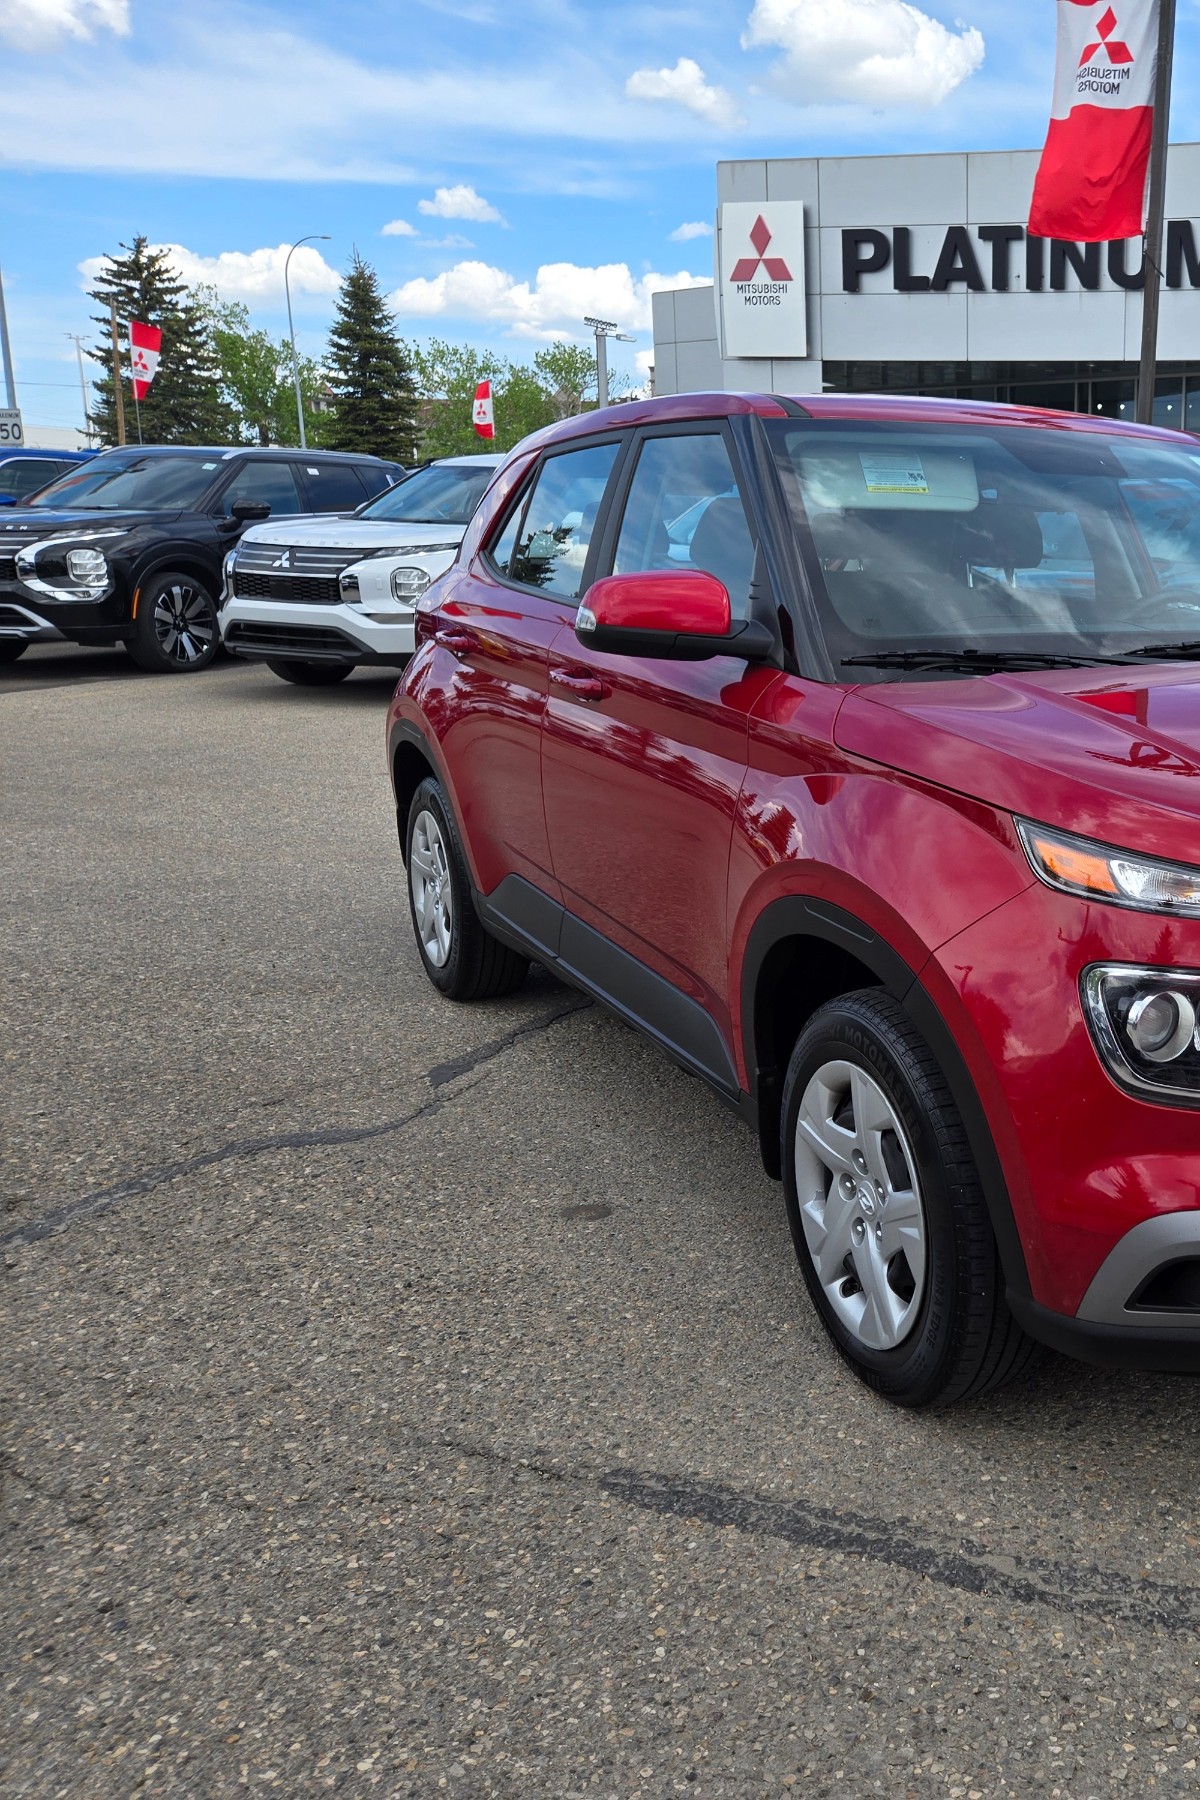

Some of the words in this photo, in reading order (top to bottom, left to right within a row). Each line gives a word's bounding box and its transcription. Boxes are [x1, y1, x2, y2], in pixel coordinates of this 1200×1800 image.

[736, 283, 788, 294] MITSUBISHI
[744, 295, 781, 306] MOTORS
[0, 423, 21, 440] 50
